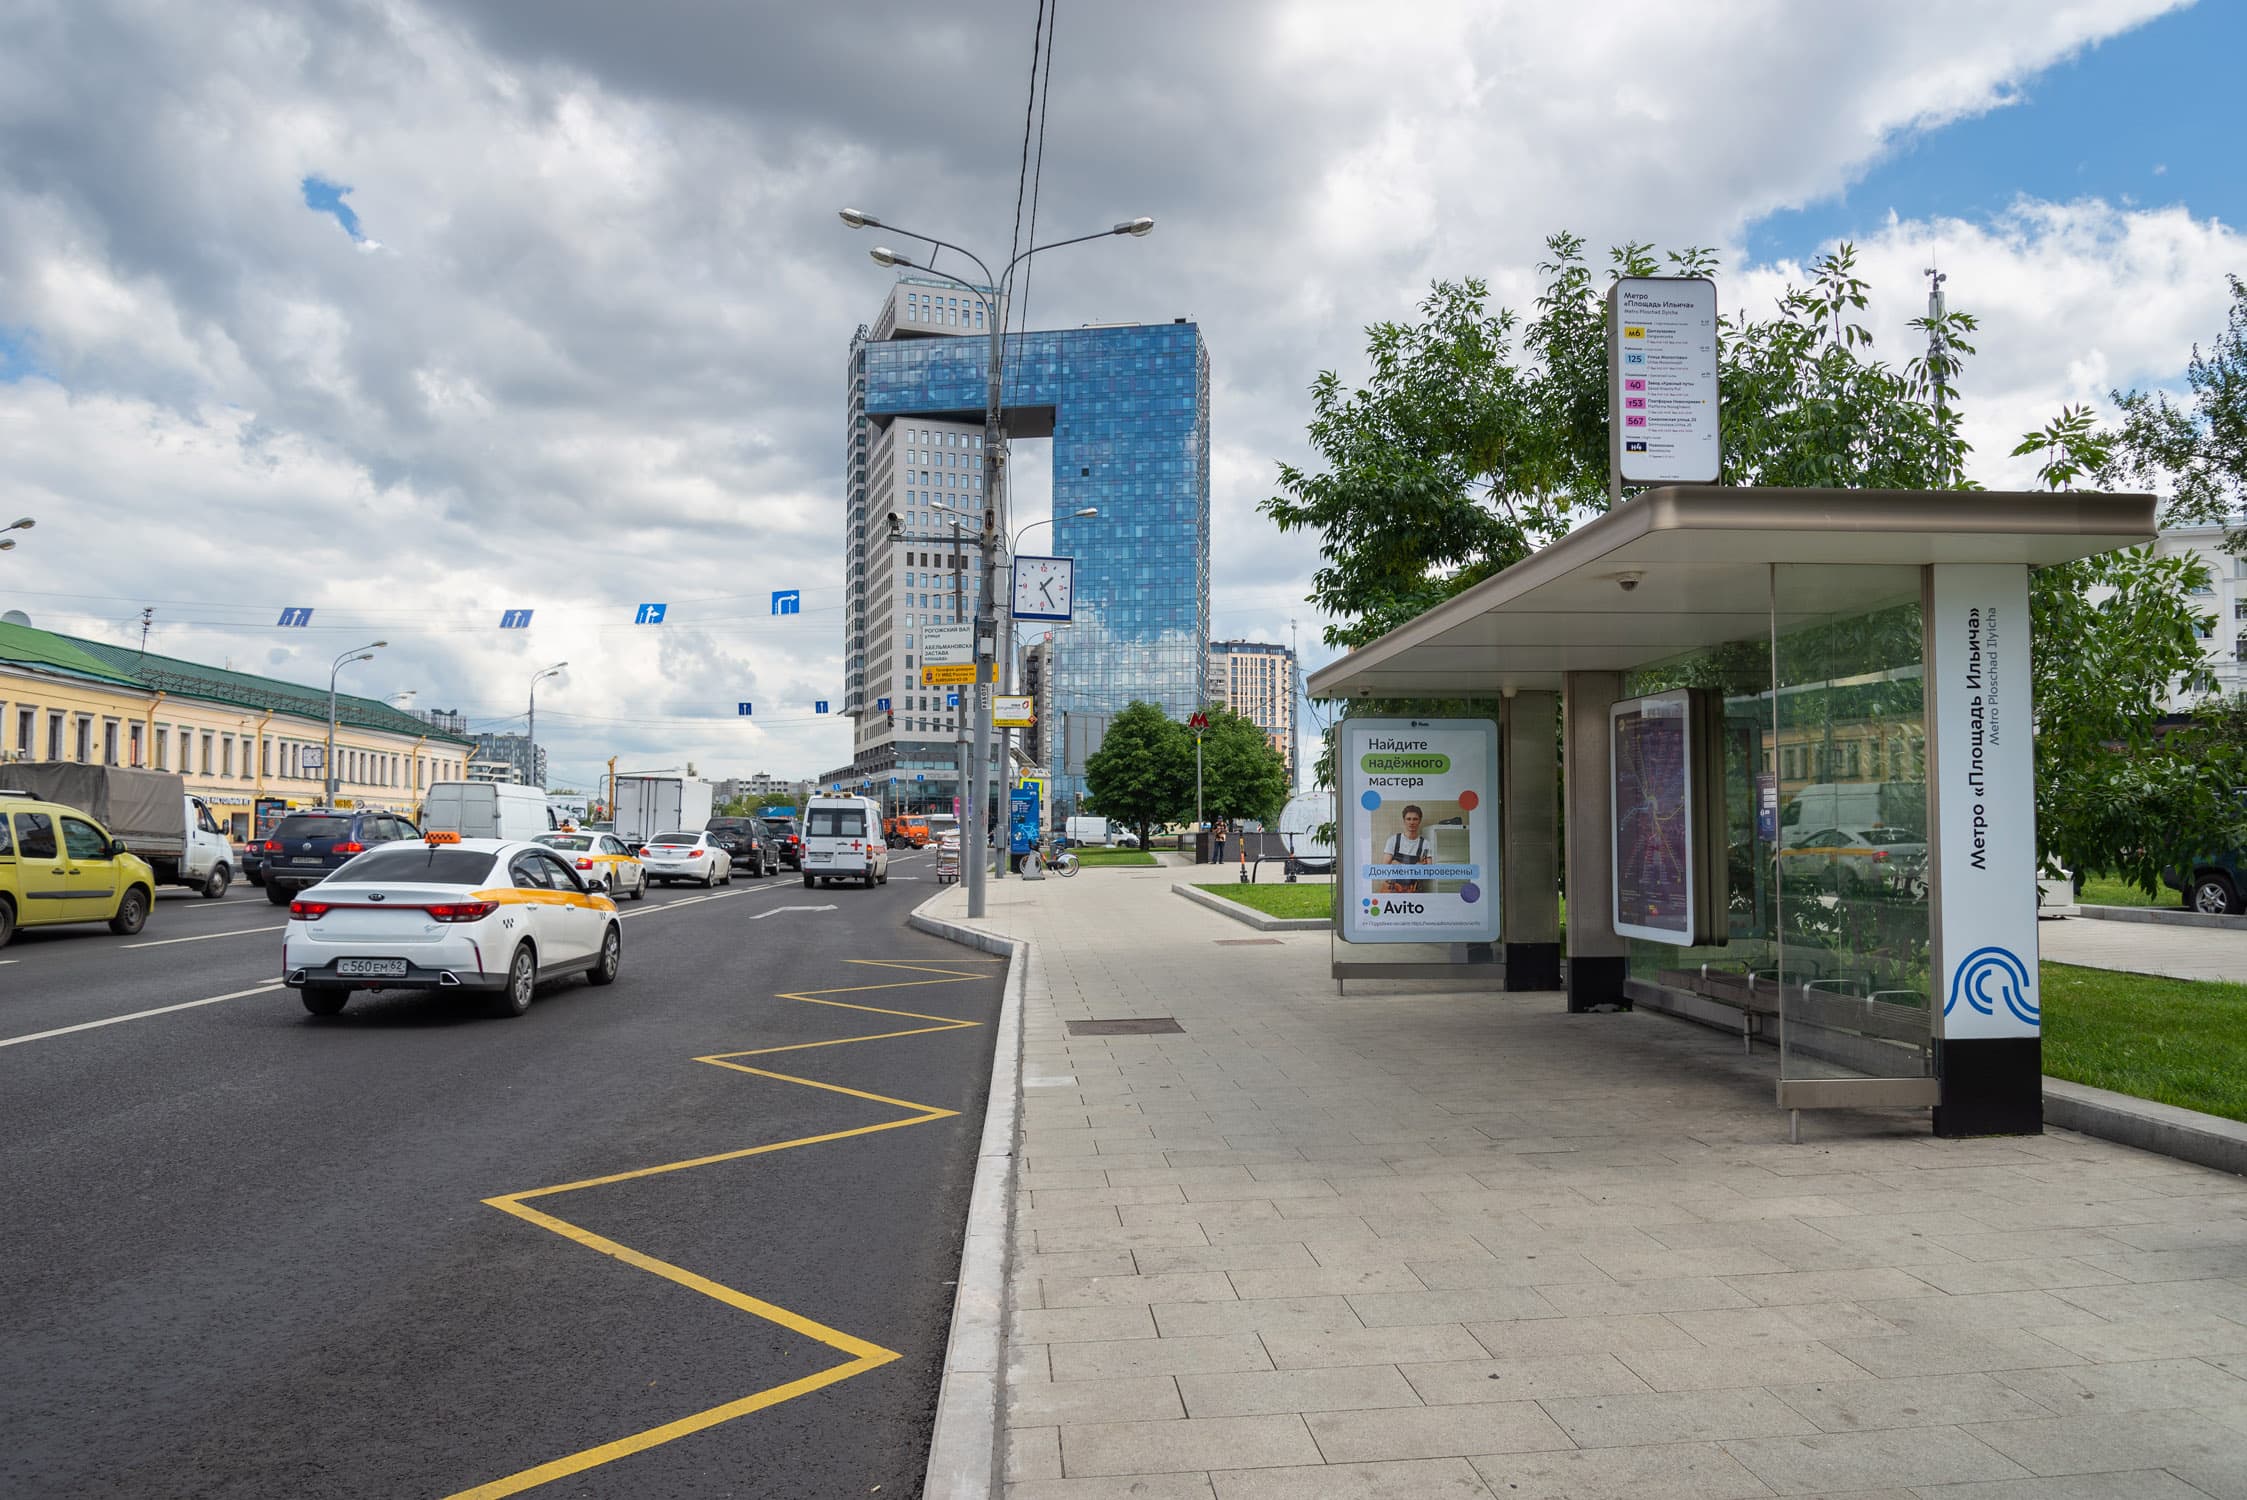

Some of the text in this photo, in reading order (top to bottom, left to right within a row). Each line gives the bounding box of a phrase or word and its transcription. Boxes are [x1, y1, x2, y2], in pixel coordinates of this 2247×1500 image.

[1623, 292, 1648, 300] Метро
[1663, 301, 1694, 309] Ильича»
[1628, 355, 1642, 363] 125
[1630, 381, 1641, 389] 40
[1628, 417, 1644, 425] 567
[924, 626, 958, 634] РОГОЖСКИЙ
[924, 643, 973, 651] АБЕЛЬМАНОВСКА
[1985, 607, 2000, 746] Metro Ploschad Ilyicha
[1966, 607, 1988, 871] Метро «Площадь Ильича»
[1368, 738, 1428, 752] Найдите
[1368, 756, 1444, 770] надёжного
[1368, 777, 1424, 788] мастера
[1369, 866, 1473, 877] Документы проверены
[1383, 900, 1425, 914] Avito
[390, 960, 402, 970] 62
